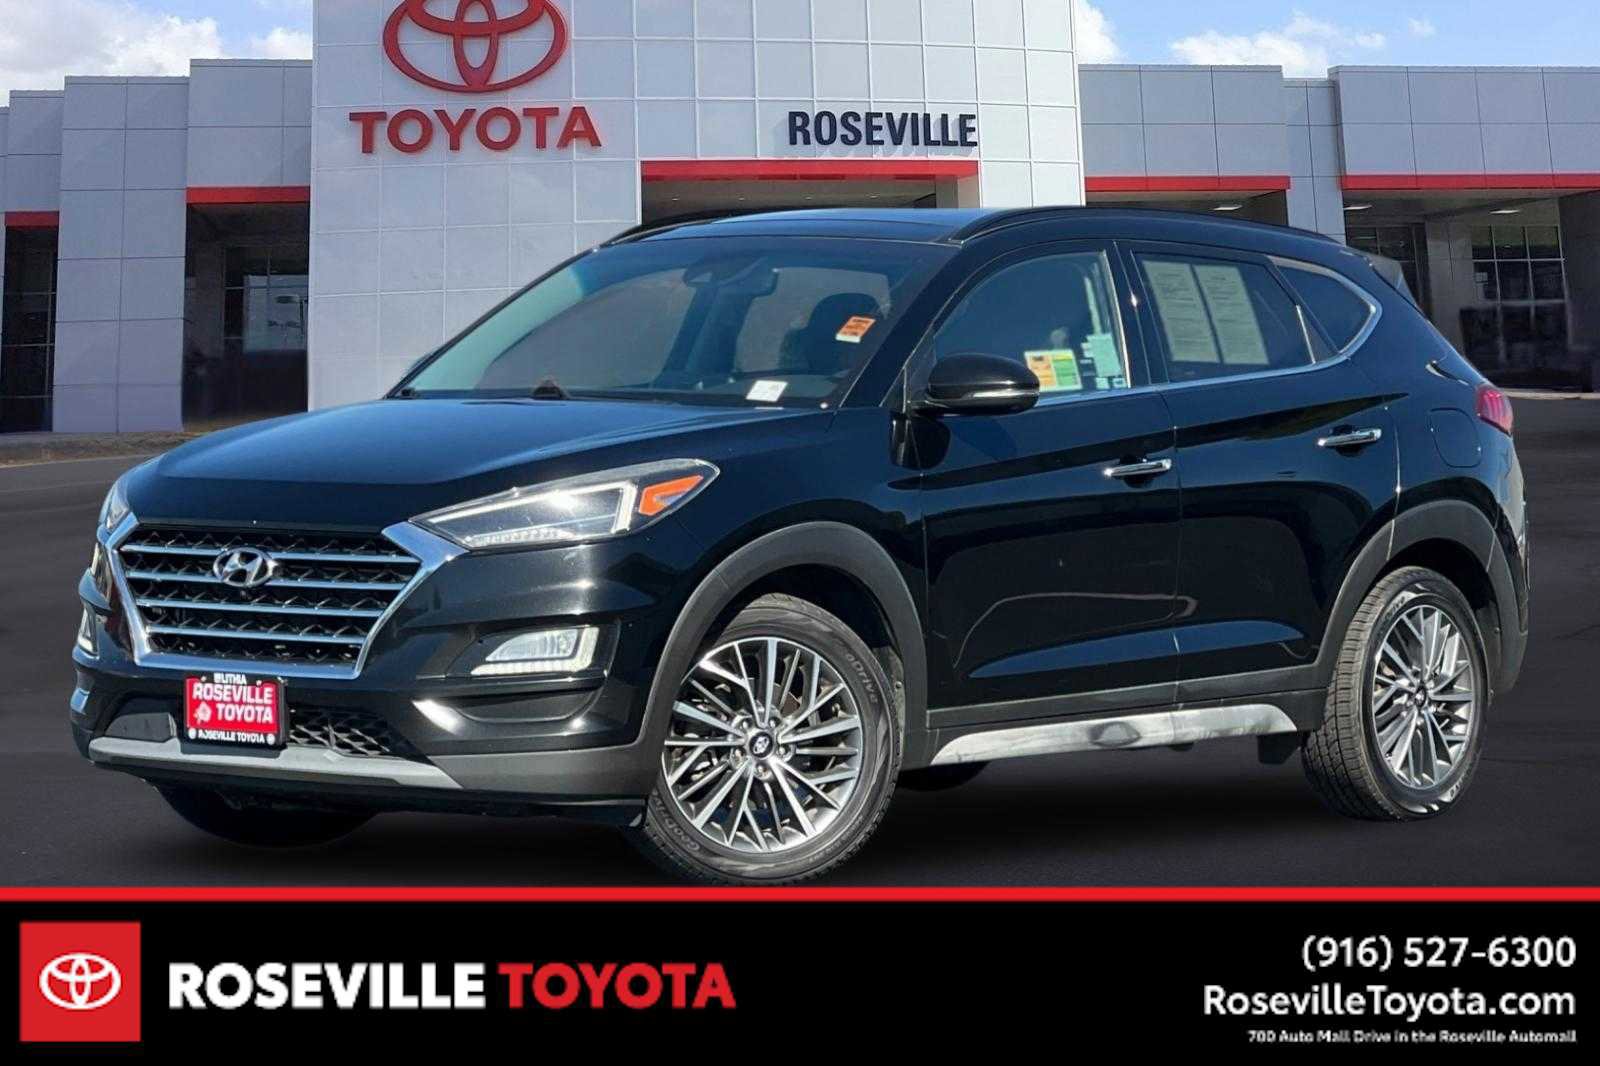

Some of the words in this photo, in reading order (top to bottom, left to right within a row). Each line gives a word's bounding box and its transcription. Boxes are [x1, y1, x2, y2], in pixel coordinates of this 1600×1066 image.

[350, 106, 602, 154] TOYOTA
[788, 110, 978, 146] ROSEVILLE
[192, 683, 272, 704] ROSEVILLE
[216, 703, 273, 724] TOYOTA
[198, 730, 236, 742] ROSEVILLE
[237, 732, 265, 744] TOYOTA
